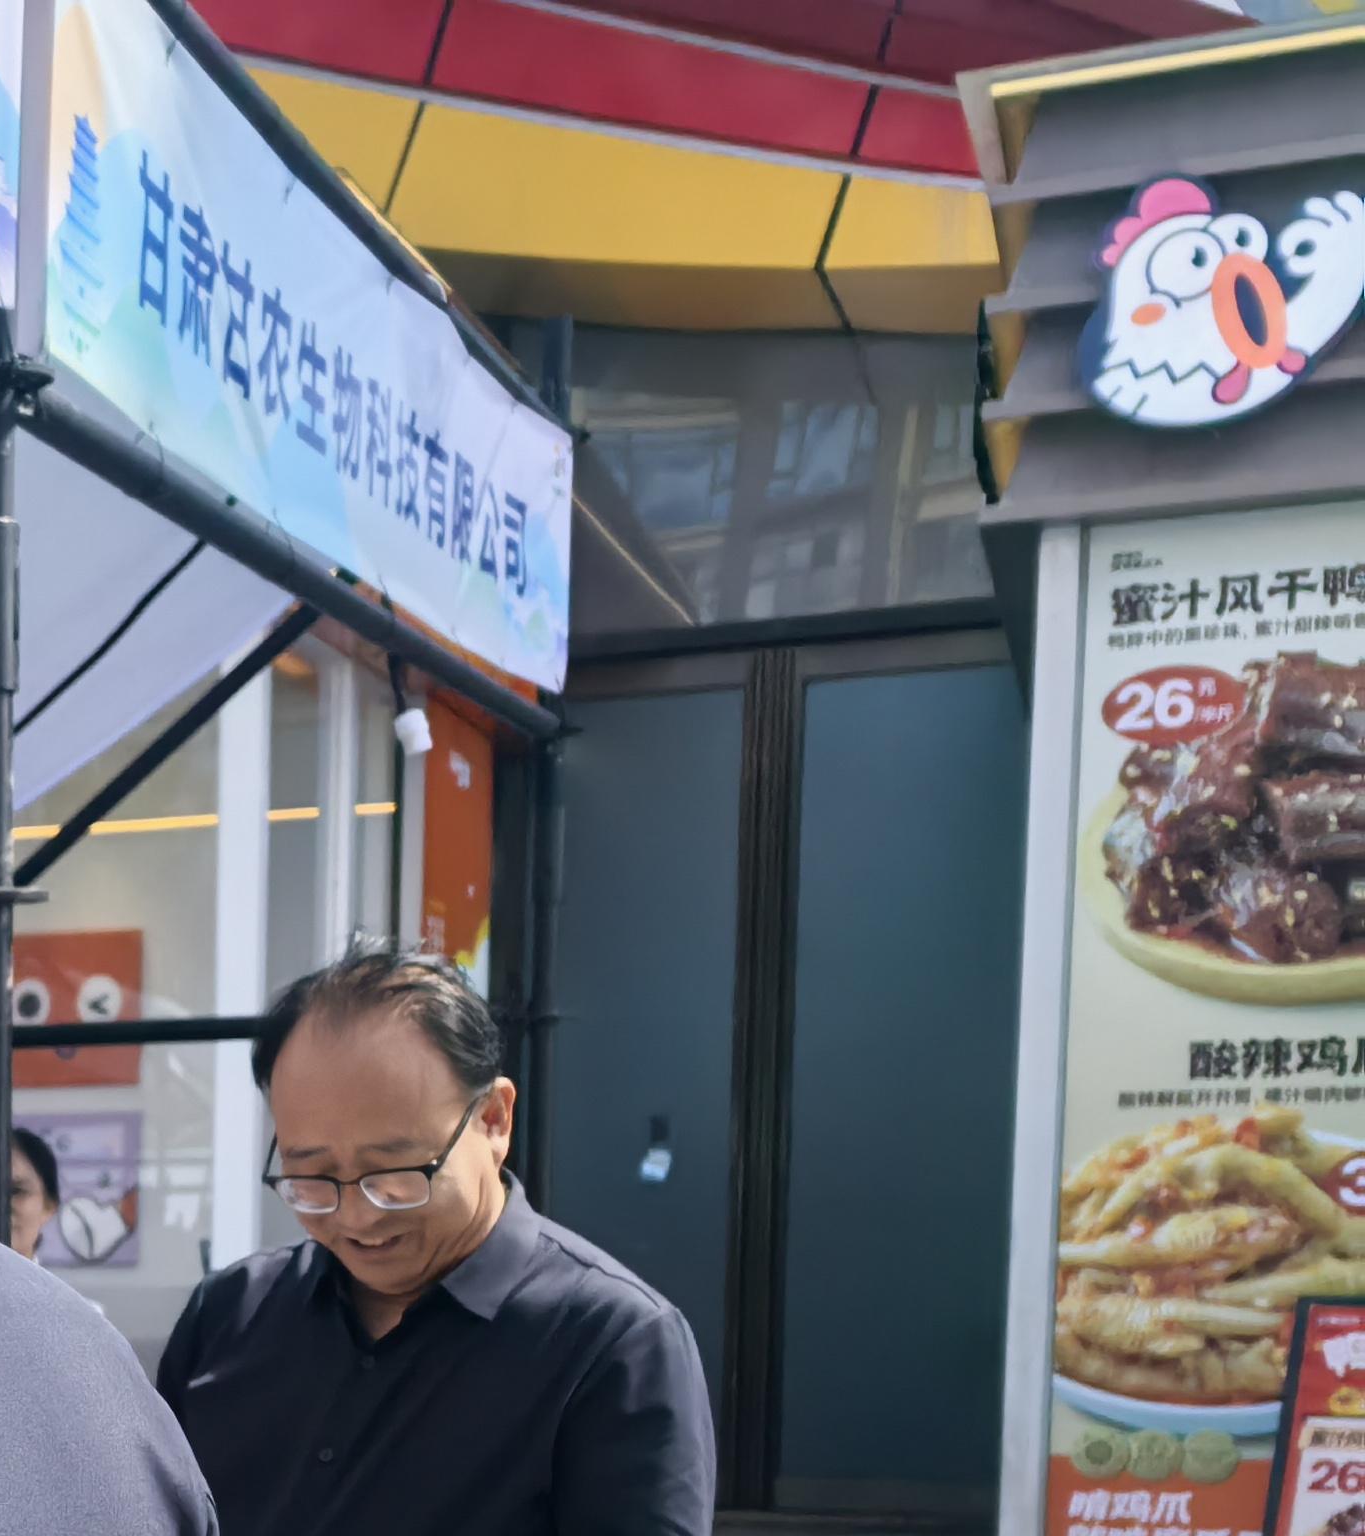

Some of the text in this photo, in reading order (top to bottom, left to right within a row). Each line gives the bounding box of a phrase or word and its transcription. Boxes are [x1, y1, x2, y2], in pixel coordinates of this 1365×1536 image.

[136, 150, 529, 598] 甘肃甘农生物科技有限公司
[1114, 677, 1196, 731] 26
[1189, 1035, 1365, 1081] 酸辣鸡
[1298, 1457, 1365, 1494] 26
